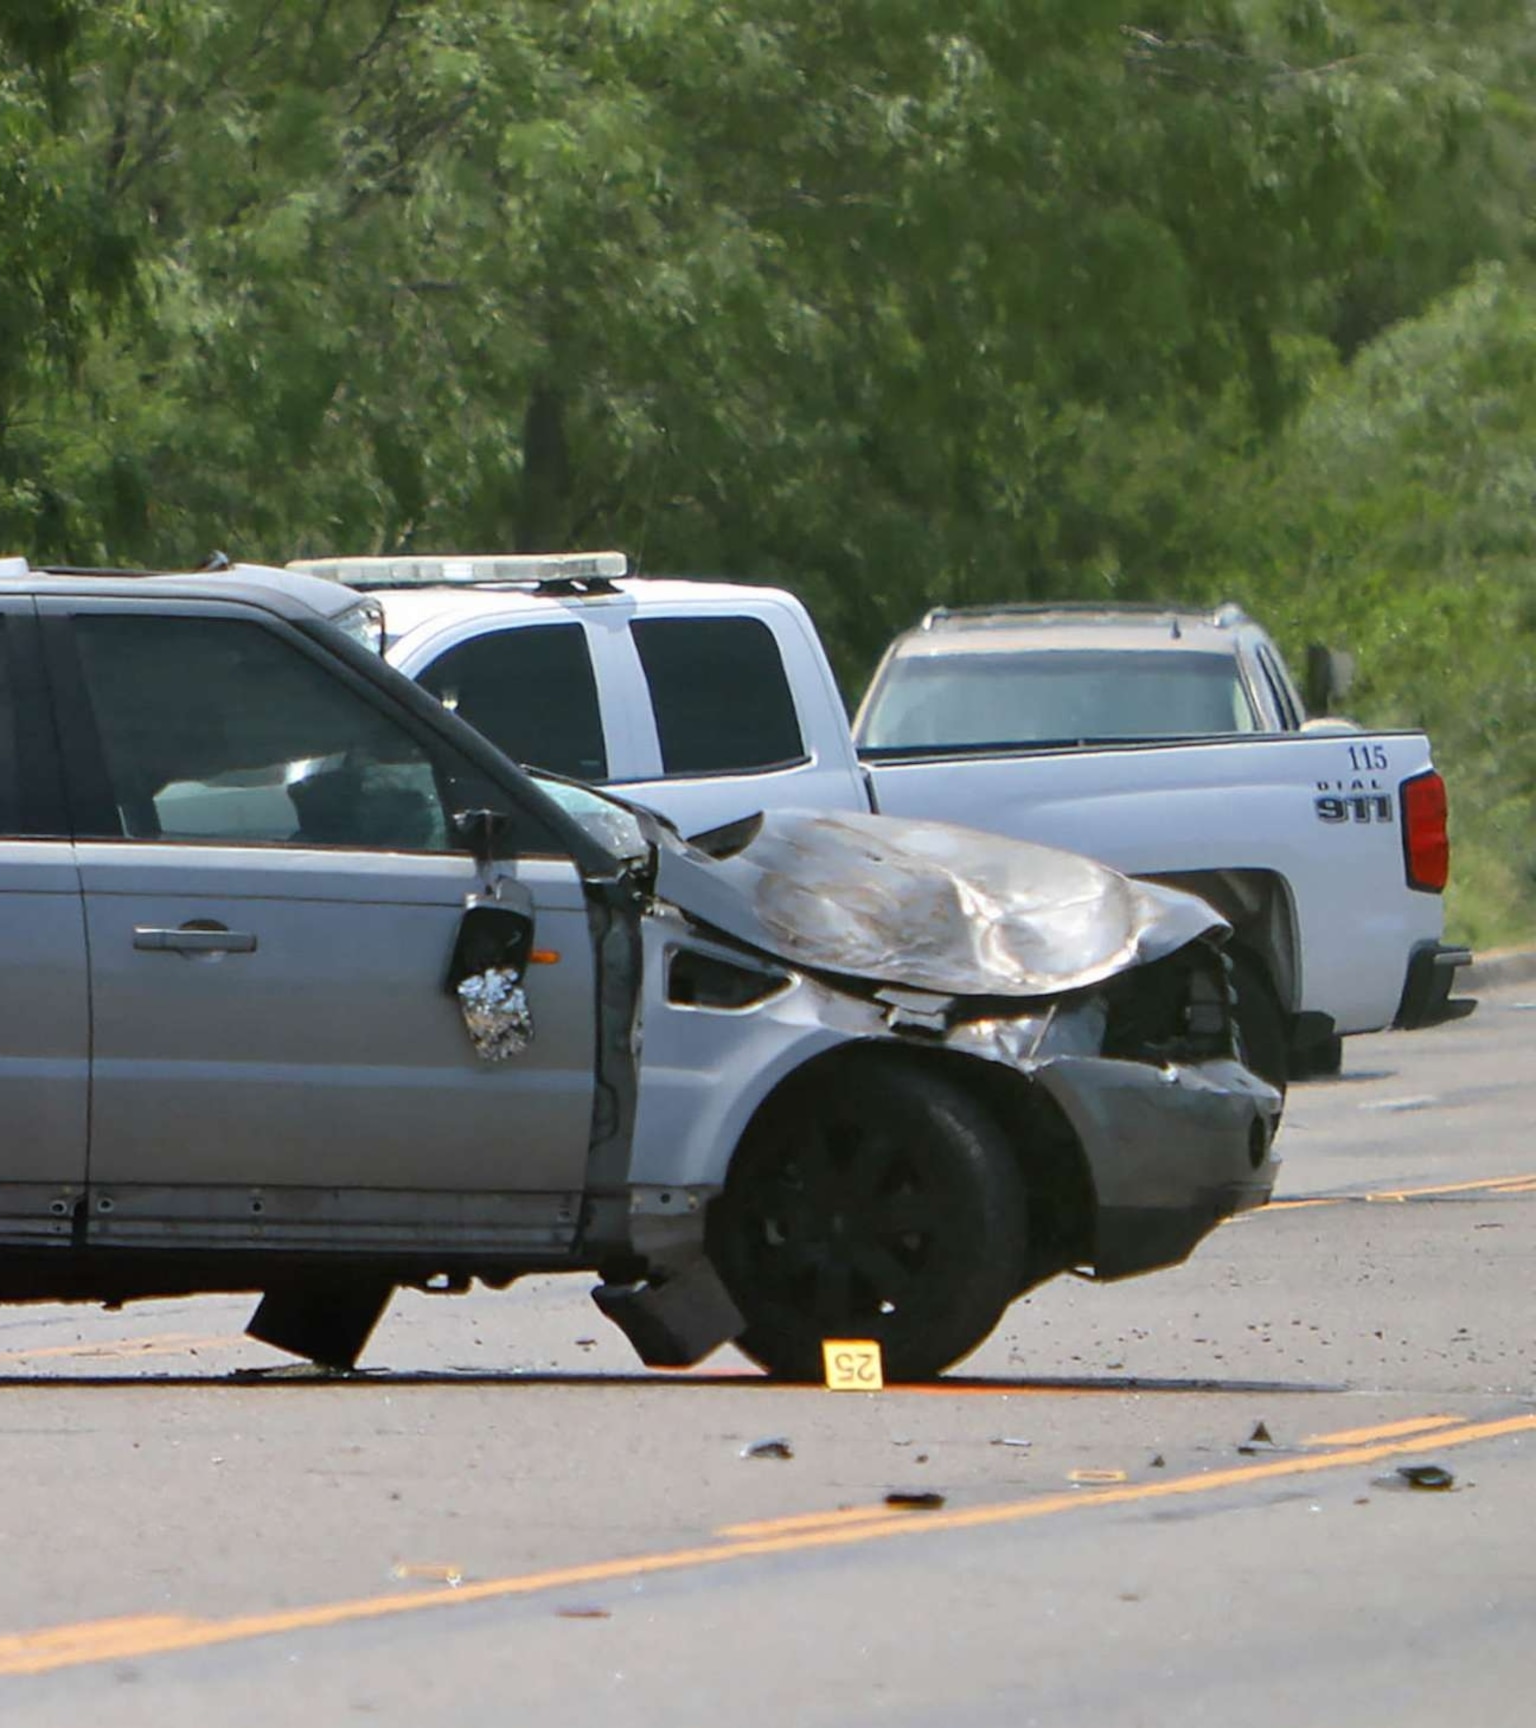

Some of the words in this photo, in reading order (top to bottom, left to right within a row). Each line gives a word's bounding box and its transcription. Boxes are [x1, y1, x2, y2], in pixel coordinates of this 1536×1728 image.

[1348, 744, 1389, 771] 115
[1316, 779, 1382, 791] DIAL
[1315, 793, 1394, 824] 911
[834, 1352, 876, 1383] 25
